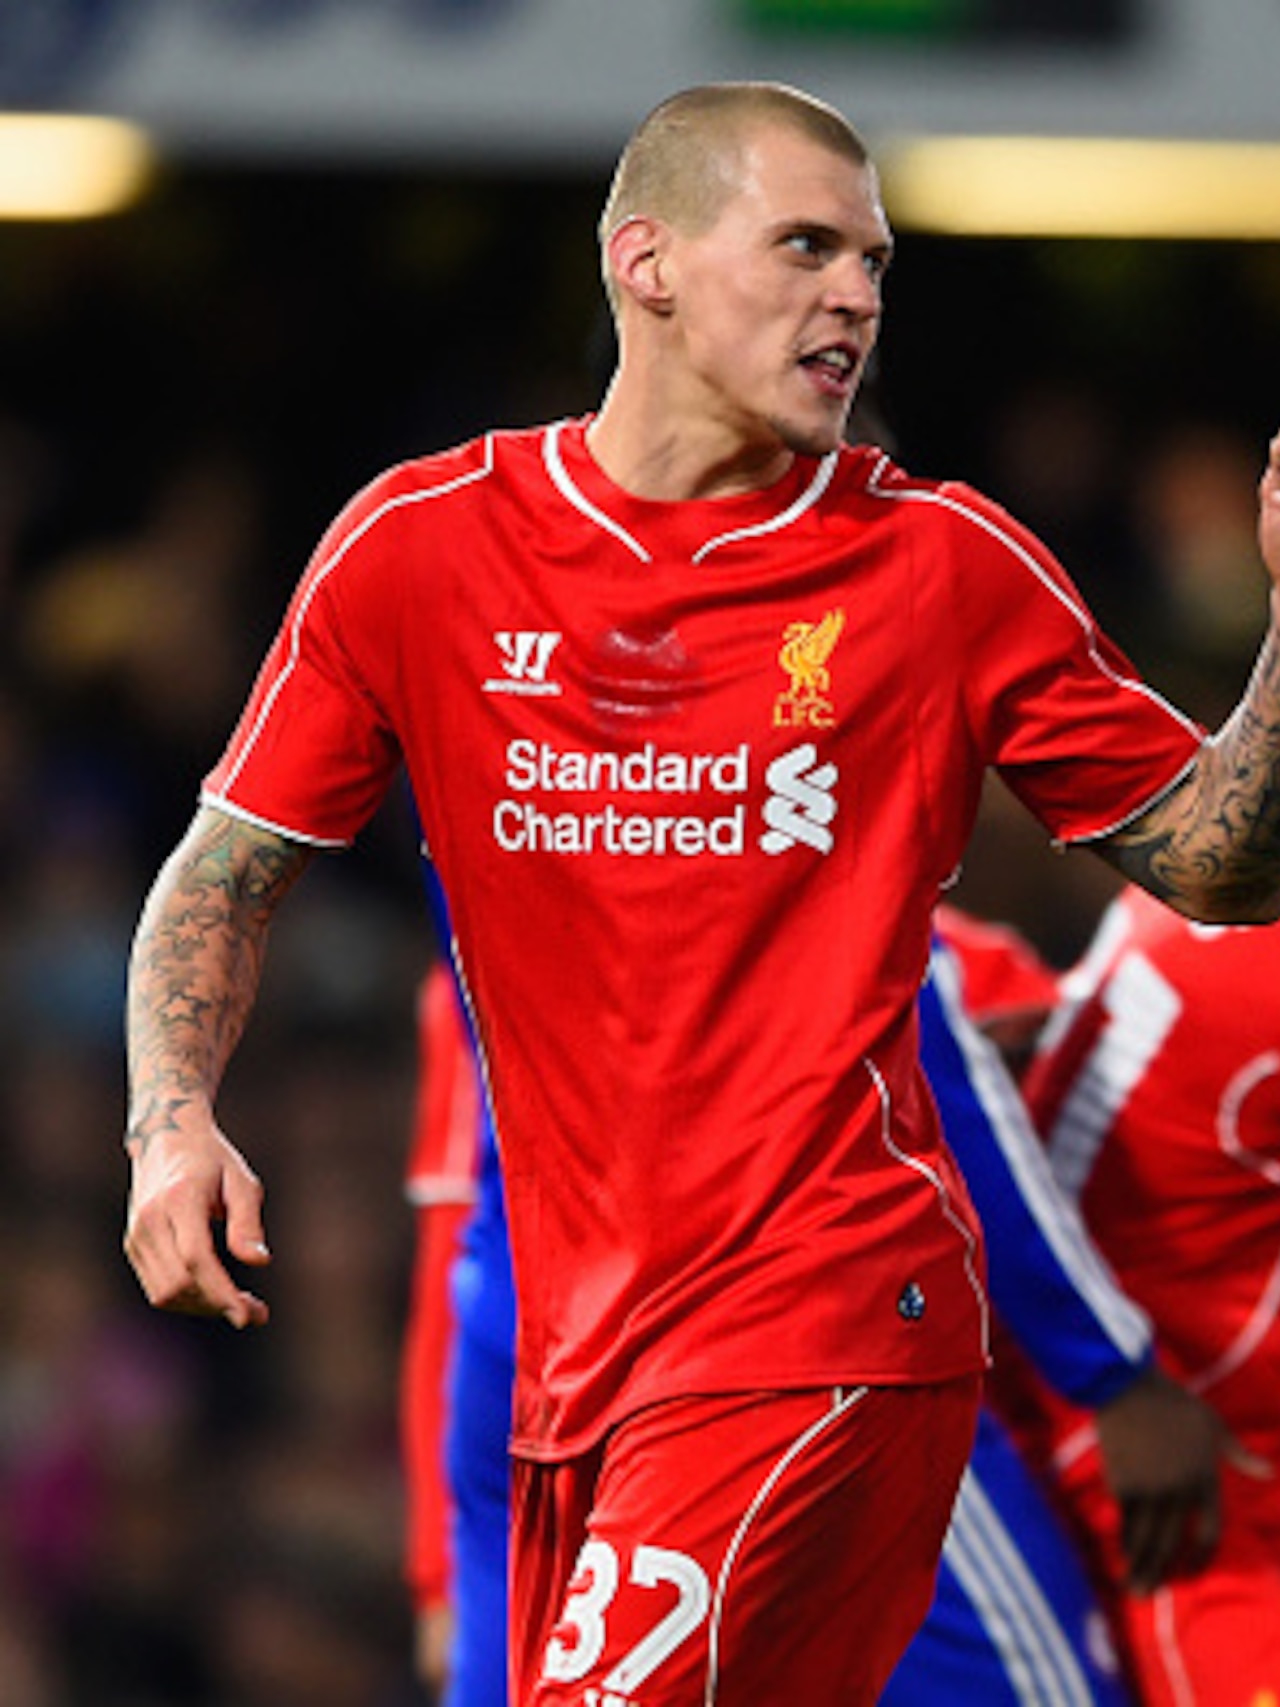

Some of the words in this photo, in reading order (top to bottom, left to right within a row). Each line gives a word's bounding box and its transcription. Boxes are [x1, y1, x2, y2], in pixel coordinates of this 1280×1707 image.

[505, 739, 749, 792] Standard
[493, 800, 745, 854] Chartered
[541, 1540, 710, 1695] 37
